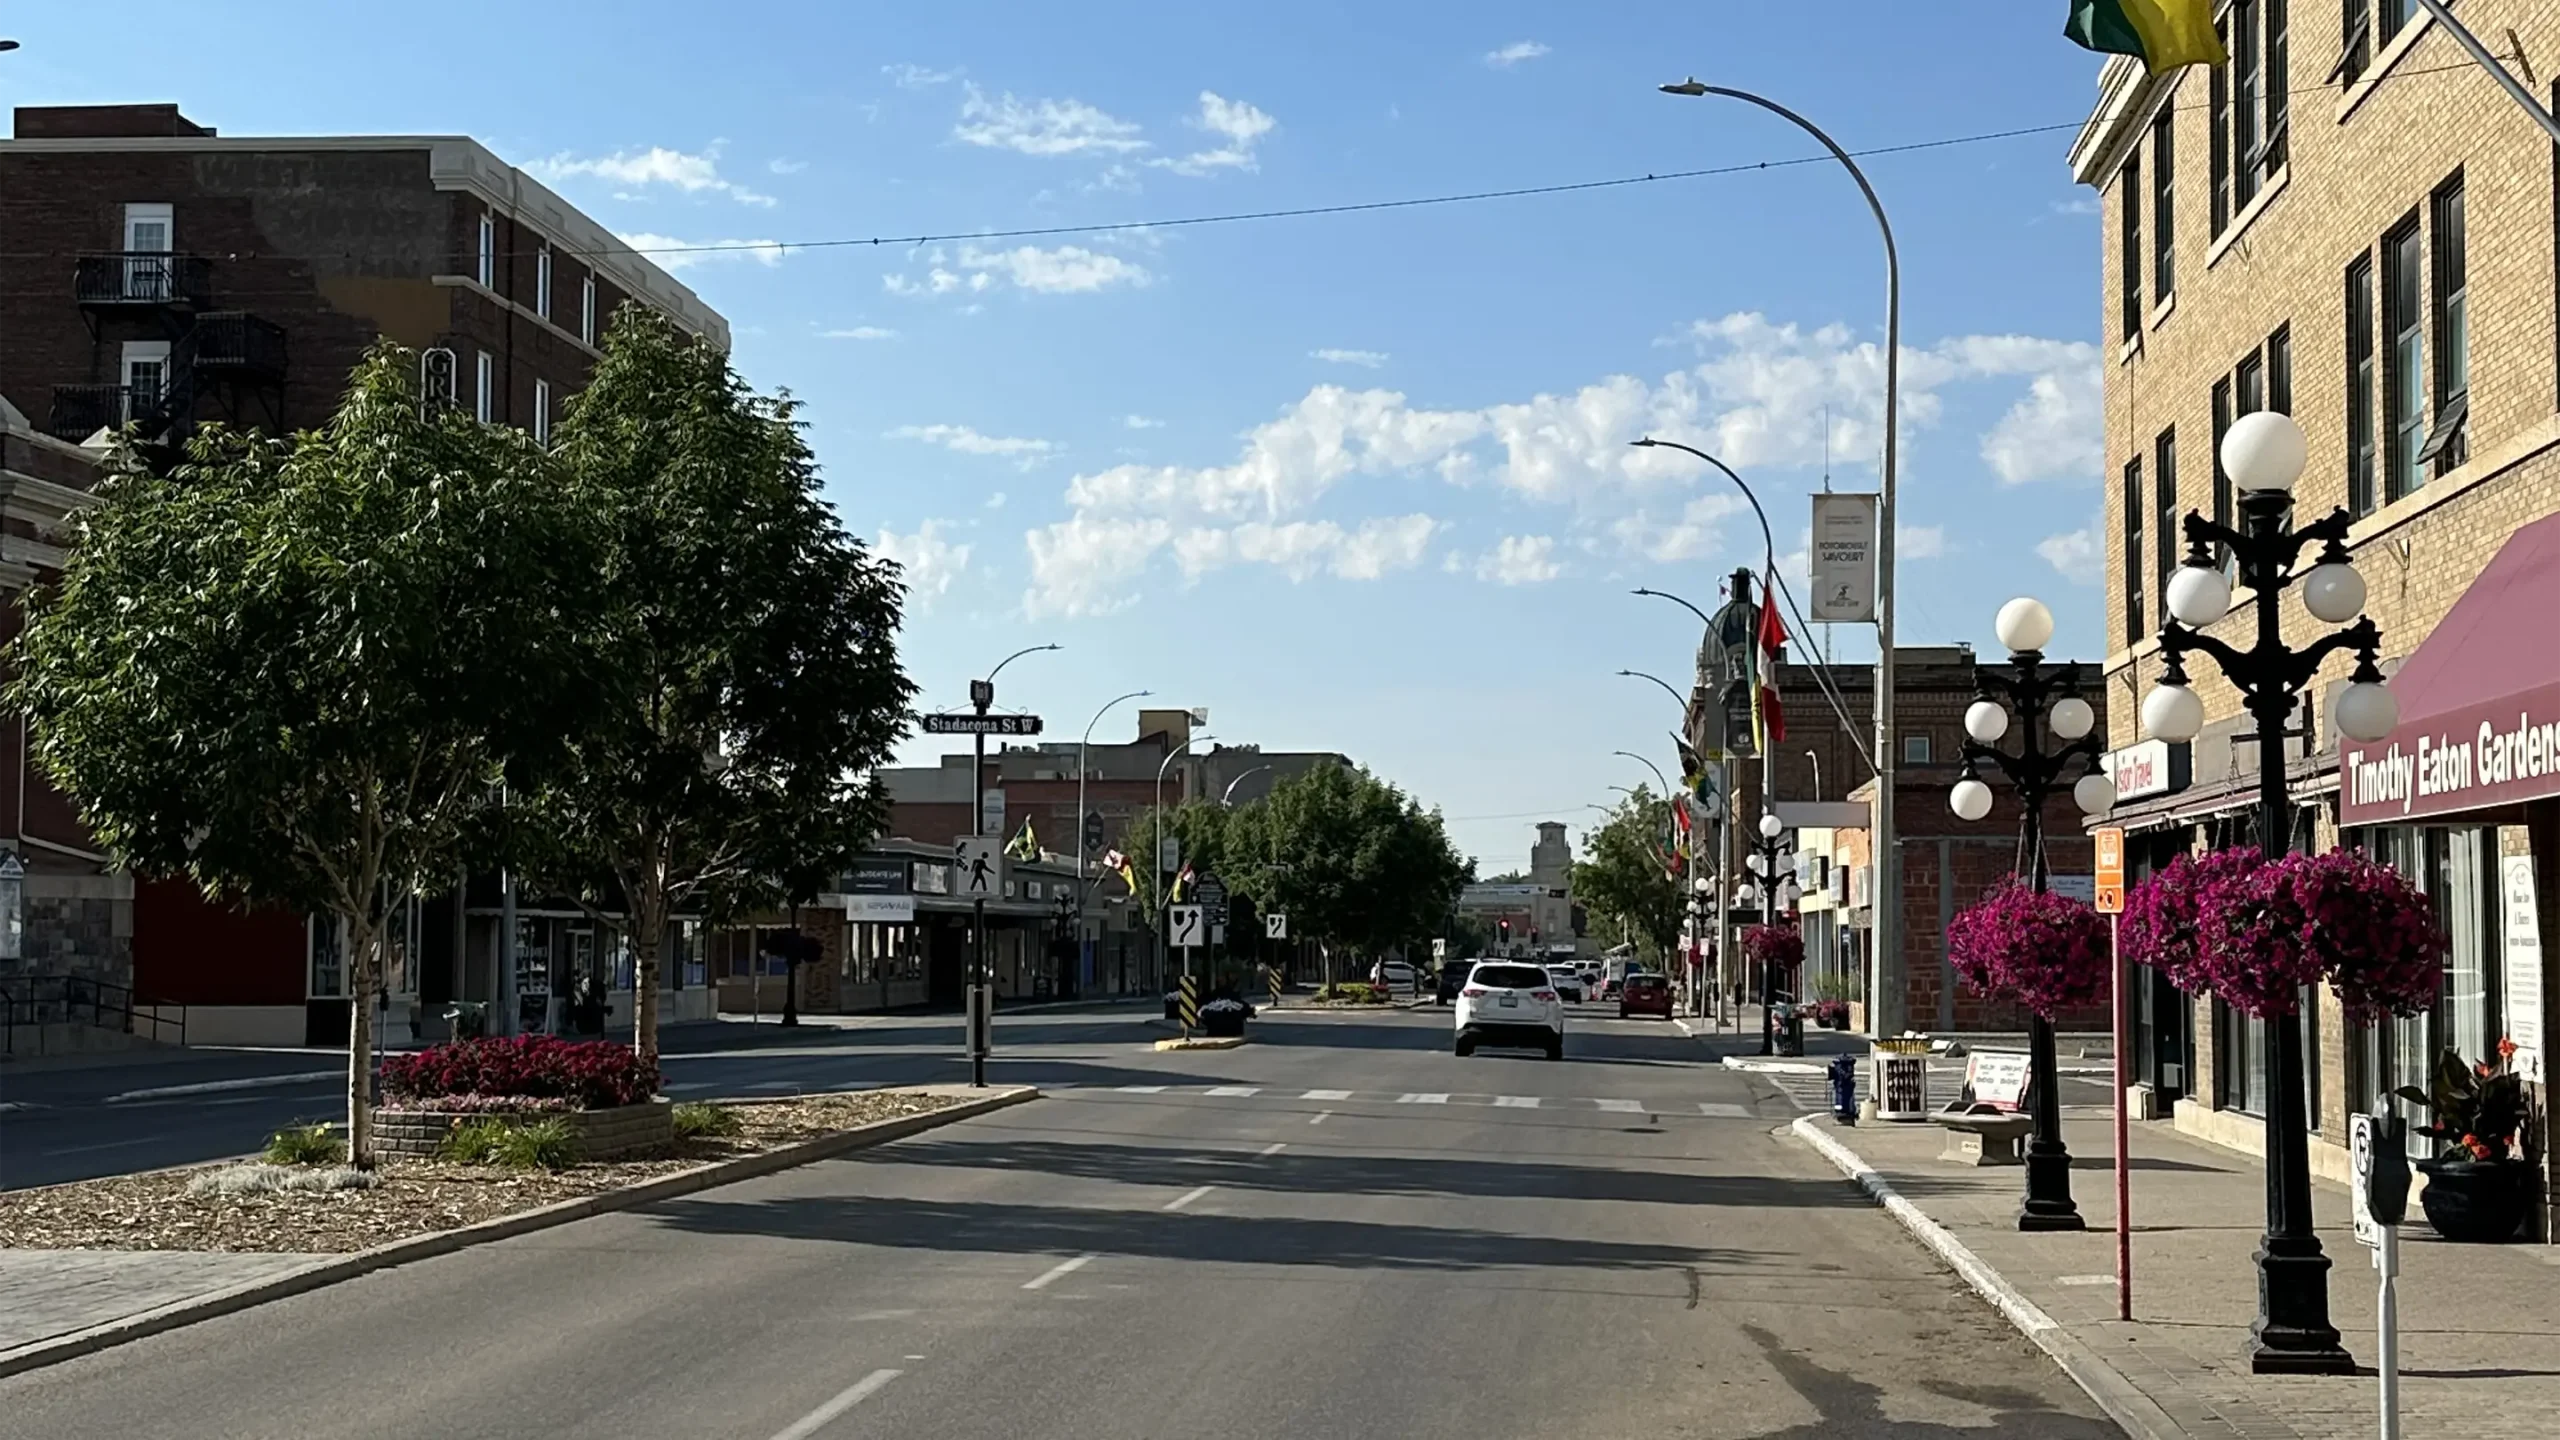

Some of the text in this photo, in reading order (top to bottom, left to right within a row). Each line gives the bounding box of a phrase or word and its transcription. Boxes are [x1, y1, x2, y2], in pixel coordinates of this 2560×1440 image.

[929, 716, 1034, 733] Stadacona St W
[2348, 742, 2414, 815] Timothy
[2418, 732, 2473, 797] Eaton
